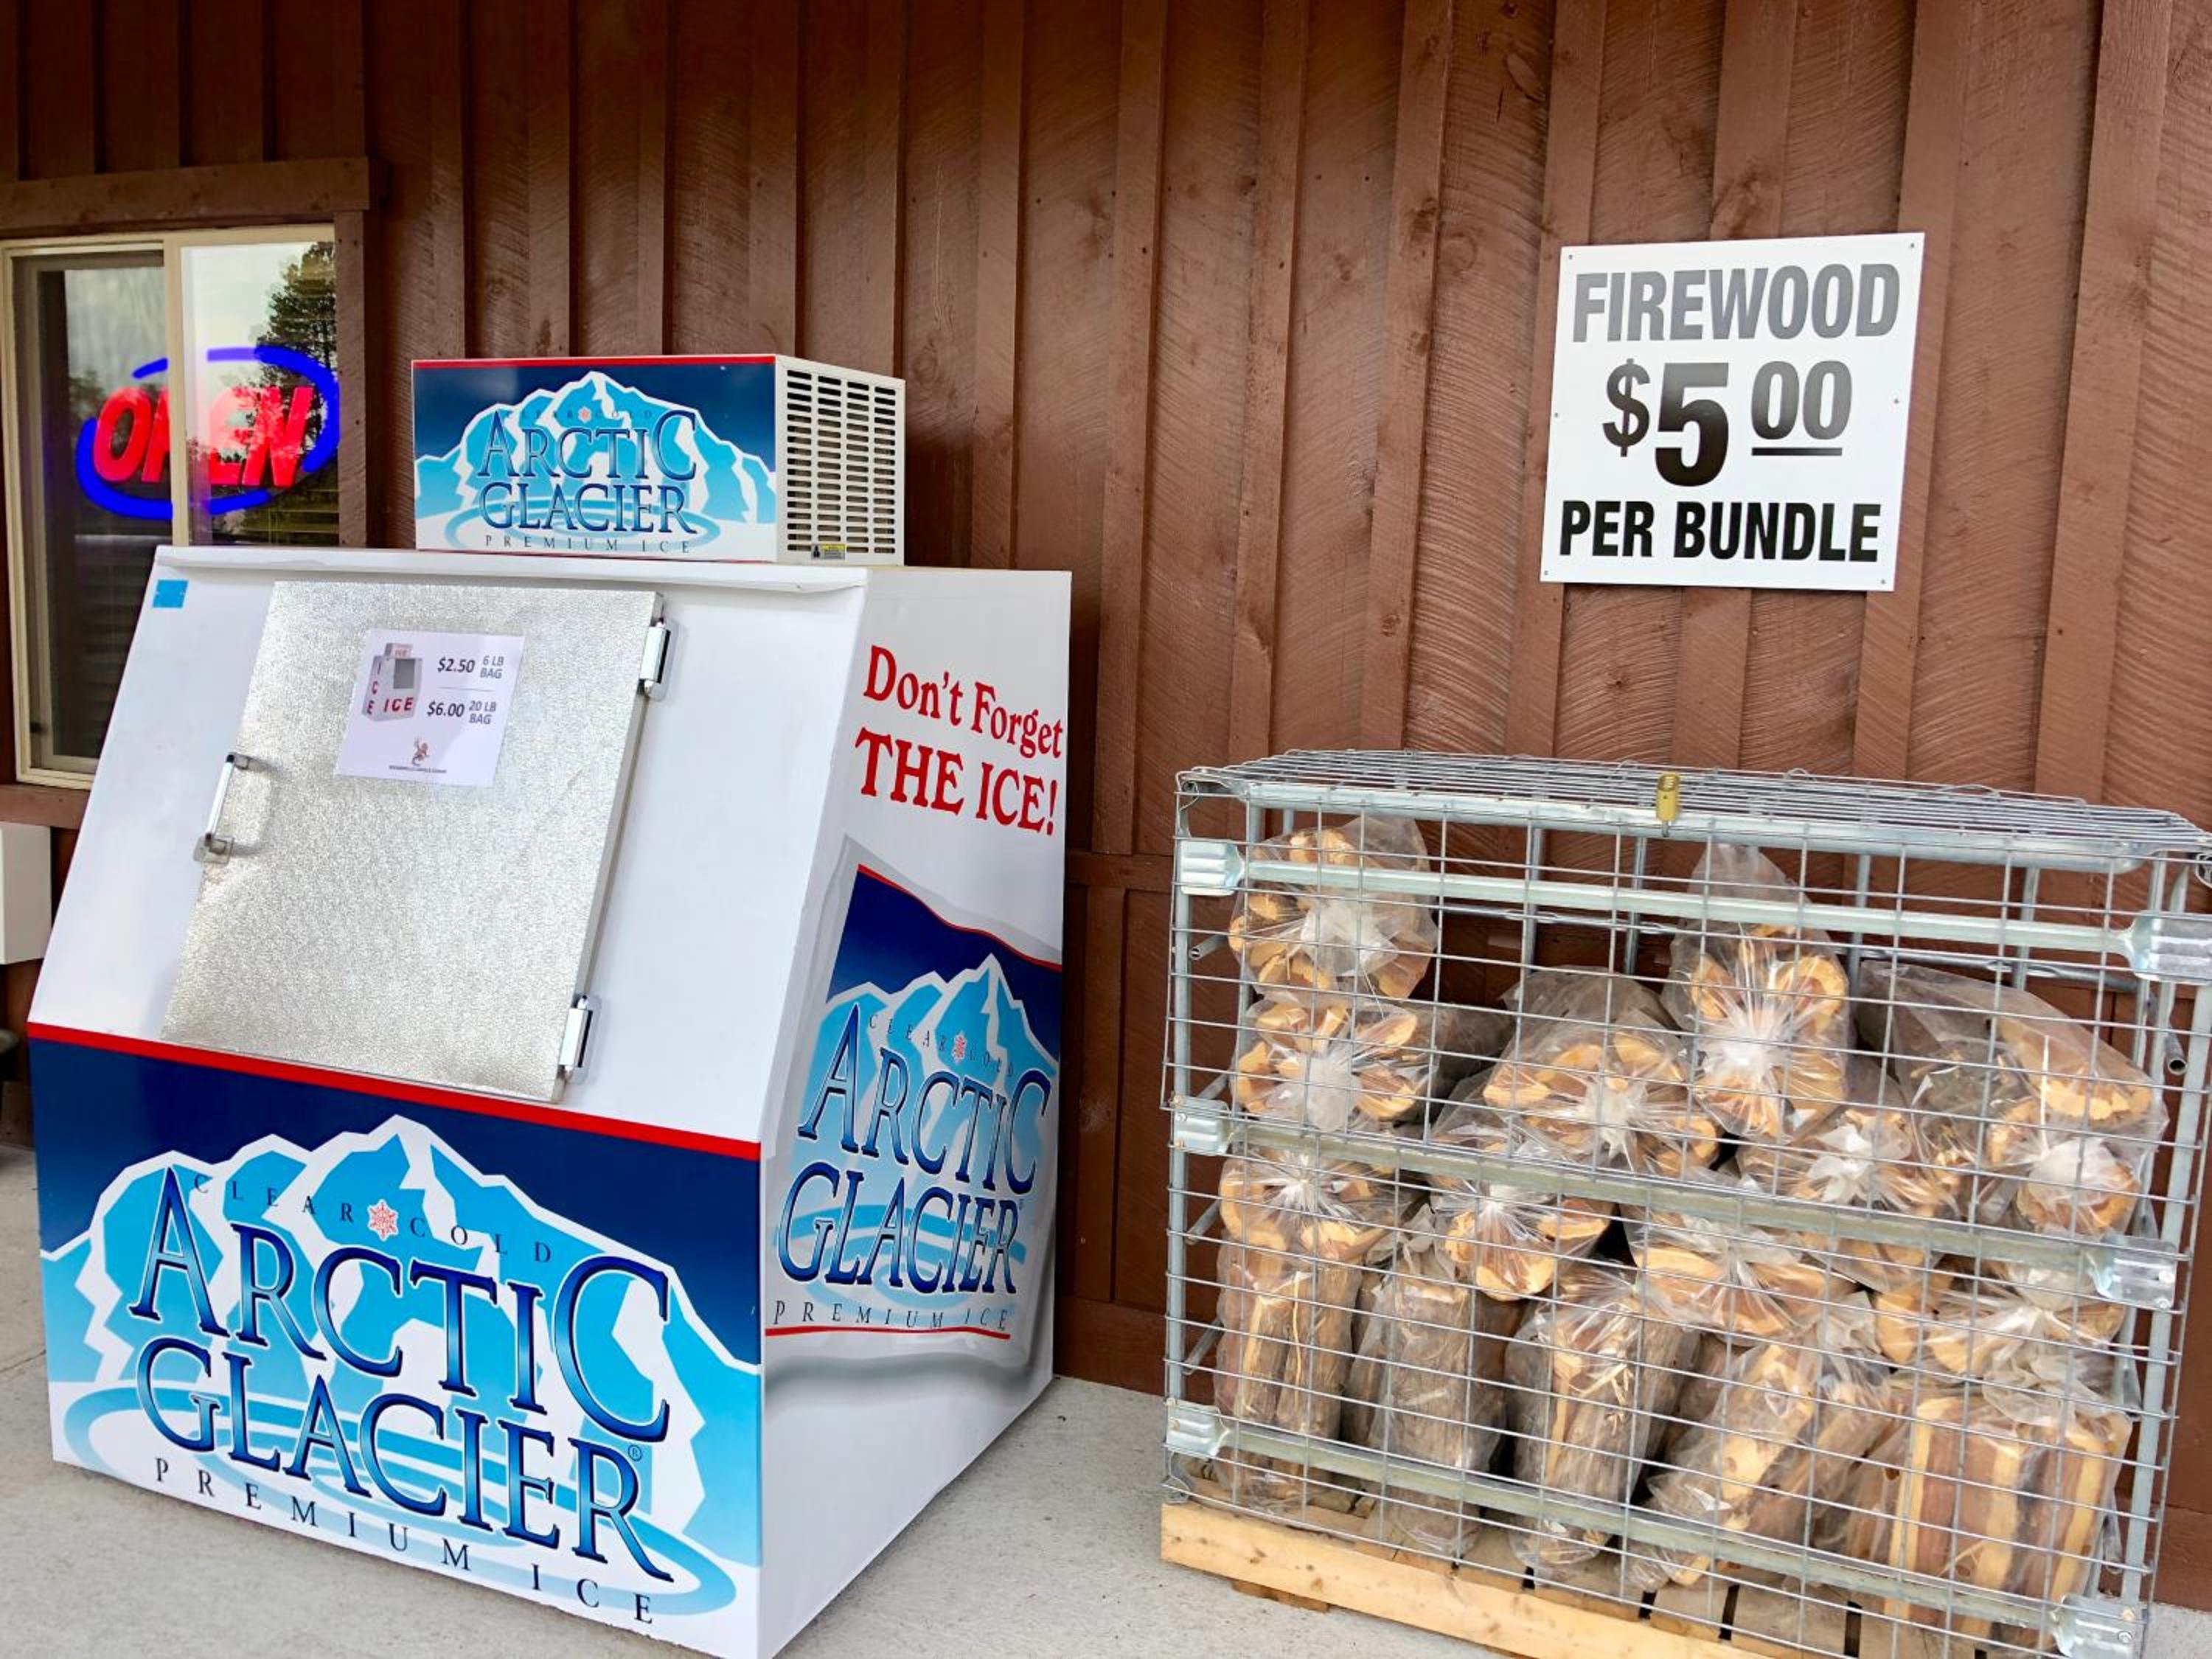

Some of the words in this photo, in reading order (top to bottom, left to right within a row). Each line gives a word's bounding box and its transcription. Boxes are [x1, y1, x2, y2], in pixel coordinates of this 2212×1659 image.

[1572, 263, 1900, 343] FIREWOOD
[478, 410, 697, 481] ARCTIC
[481, 481, 698, 534] GLACIER
[1559, 499, 1655, 557] PER
[1673, 501, 1882, 563] BUNDLE
[486, 535, 618, 552] PREMIUM
[642, 540, 689, 553] ICE
[437, 655, 476, 673] $2.50
[483, 655, 490, 666] 6
[492, 655, 504, 667] LB
[480, 667, 503, 679] BAG
[384, 697, 414, 713] ICE
[427, 700, 465, 717] $6.00
[469, 700, 482, 712] 20
[484, 701, 496, 712] LB
[469, 713, 492, 725] BAG
[863, 644, 963, 726] Don't
[971, 681, 1063, 759] Forget
[854, 727, 964, 815] THE
[975, 762, 1057, 836] ICE!
[797, 1003, 1051, 1194] ARCTIC
[193, 1173, 354, 1223] CLEAR
[410, 1217, 552, 1263] COLD
[778, 1161, 1018, 1295] GLACIER
[128, 1166, 670, 1443] ARCTIC
[773, 1299, 945, 1329] PREMIUM
[964, 1307, 1009, 1330] ICE
[155, 1457, 471, 1571] PREMIUM
[531, 1563, 653, 1624] ICE
